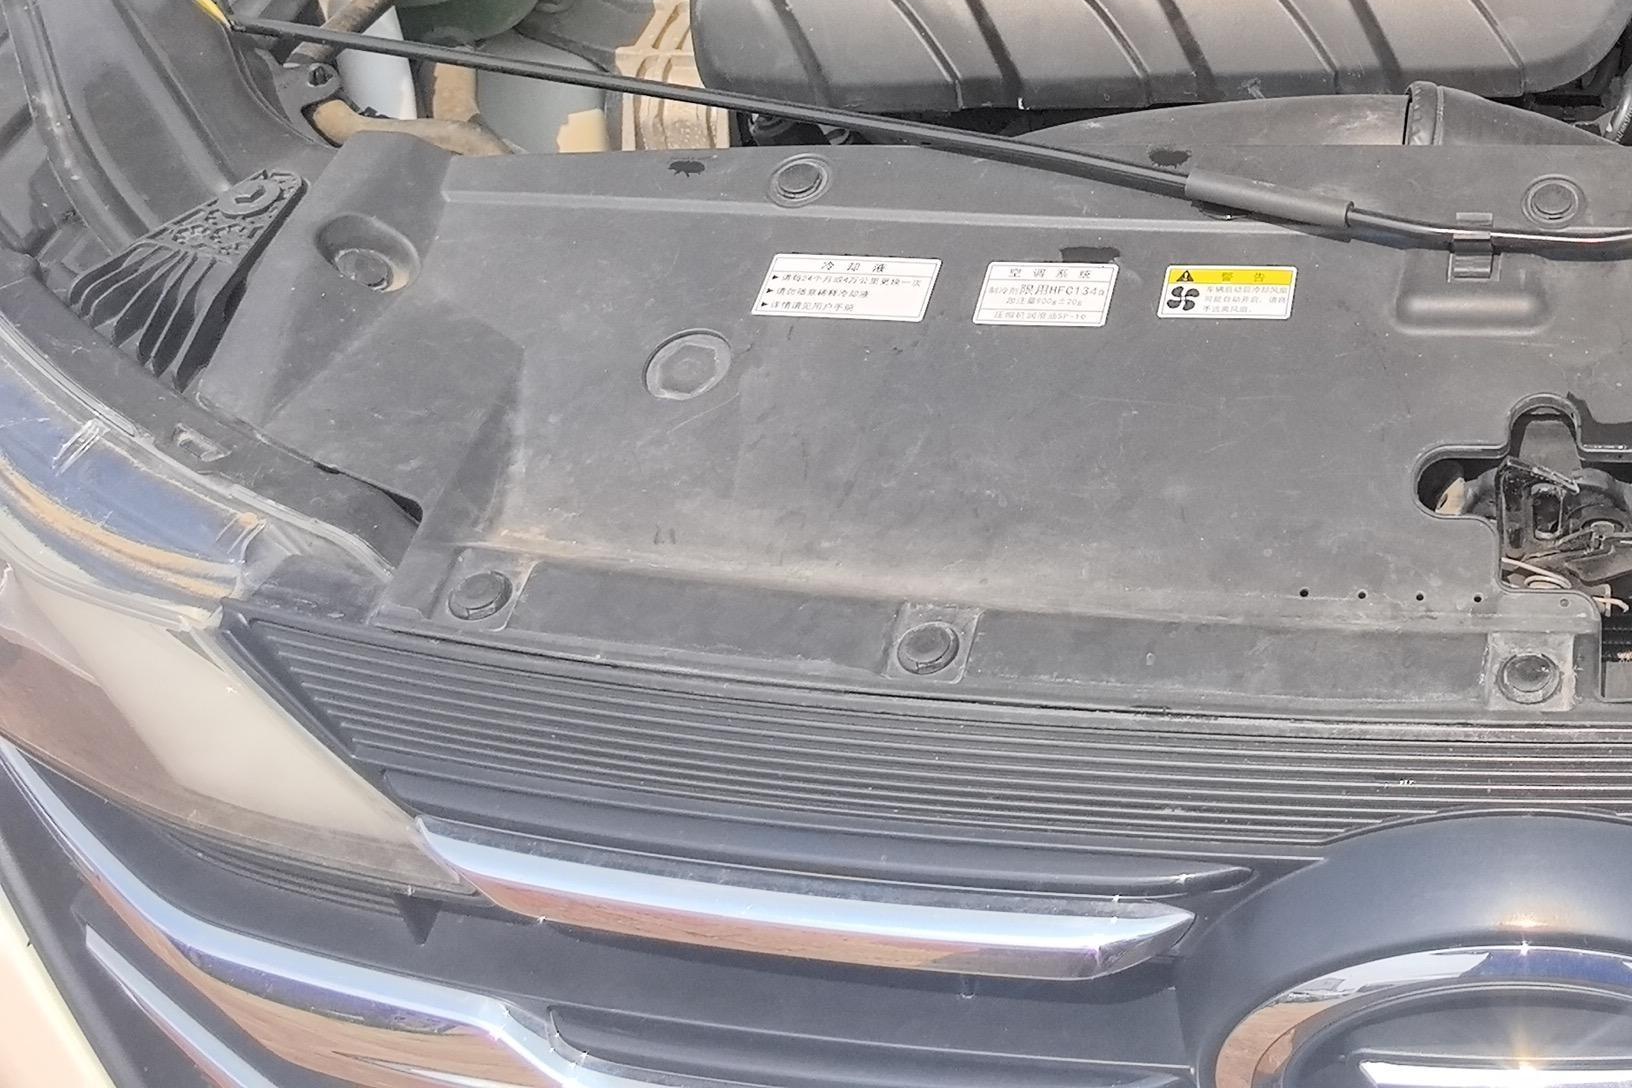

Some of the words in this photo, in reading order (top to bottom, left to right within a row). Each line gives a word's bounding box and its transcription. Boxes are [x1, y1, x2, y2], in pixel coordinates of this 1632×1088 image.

[821, 261, 886, 273] 冷却液
[1008, 268, 1091, 279] 空调系统
[1222, 272, 1264, 282] 警告
